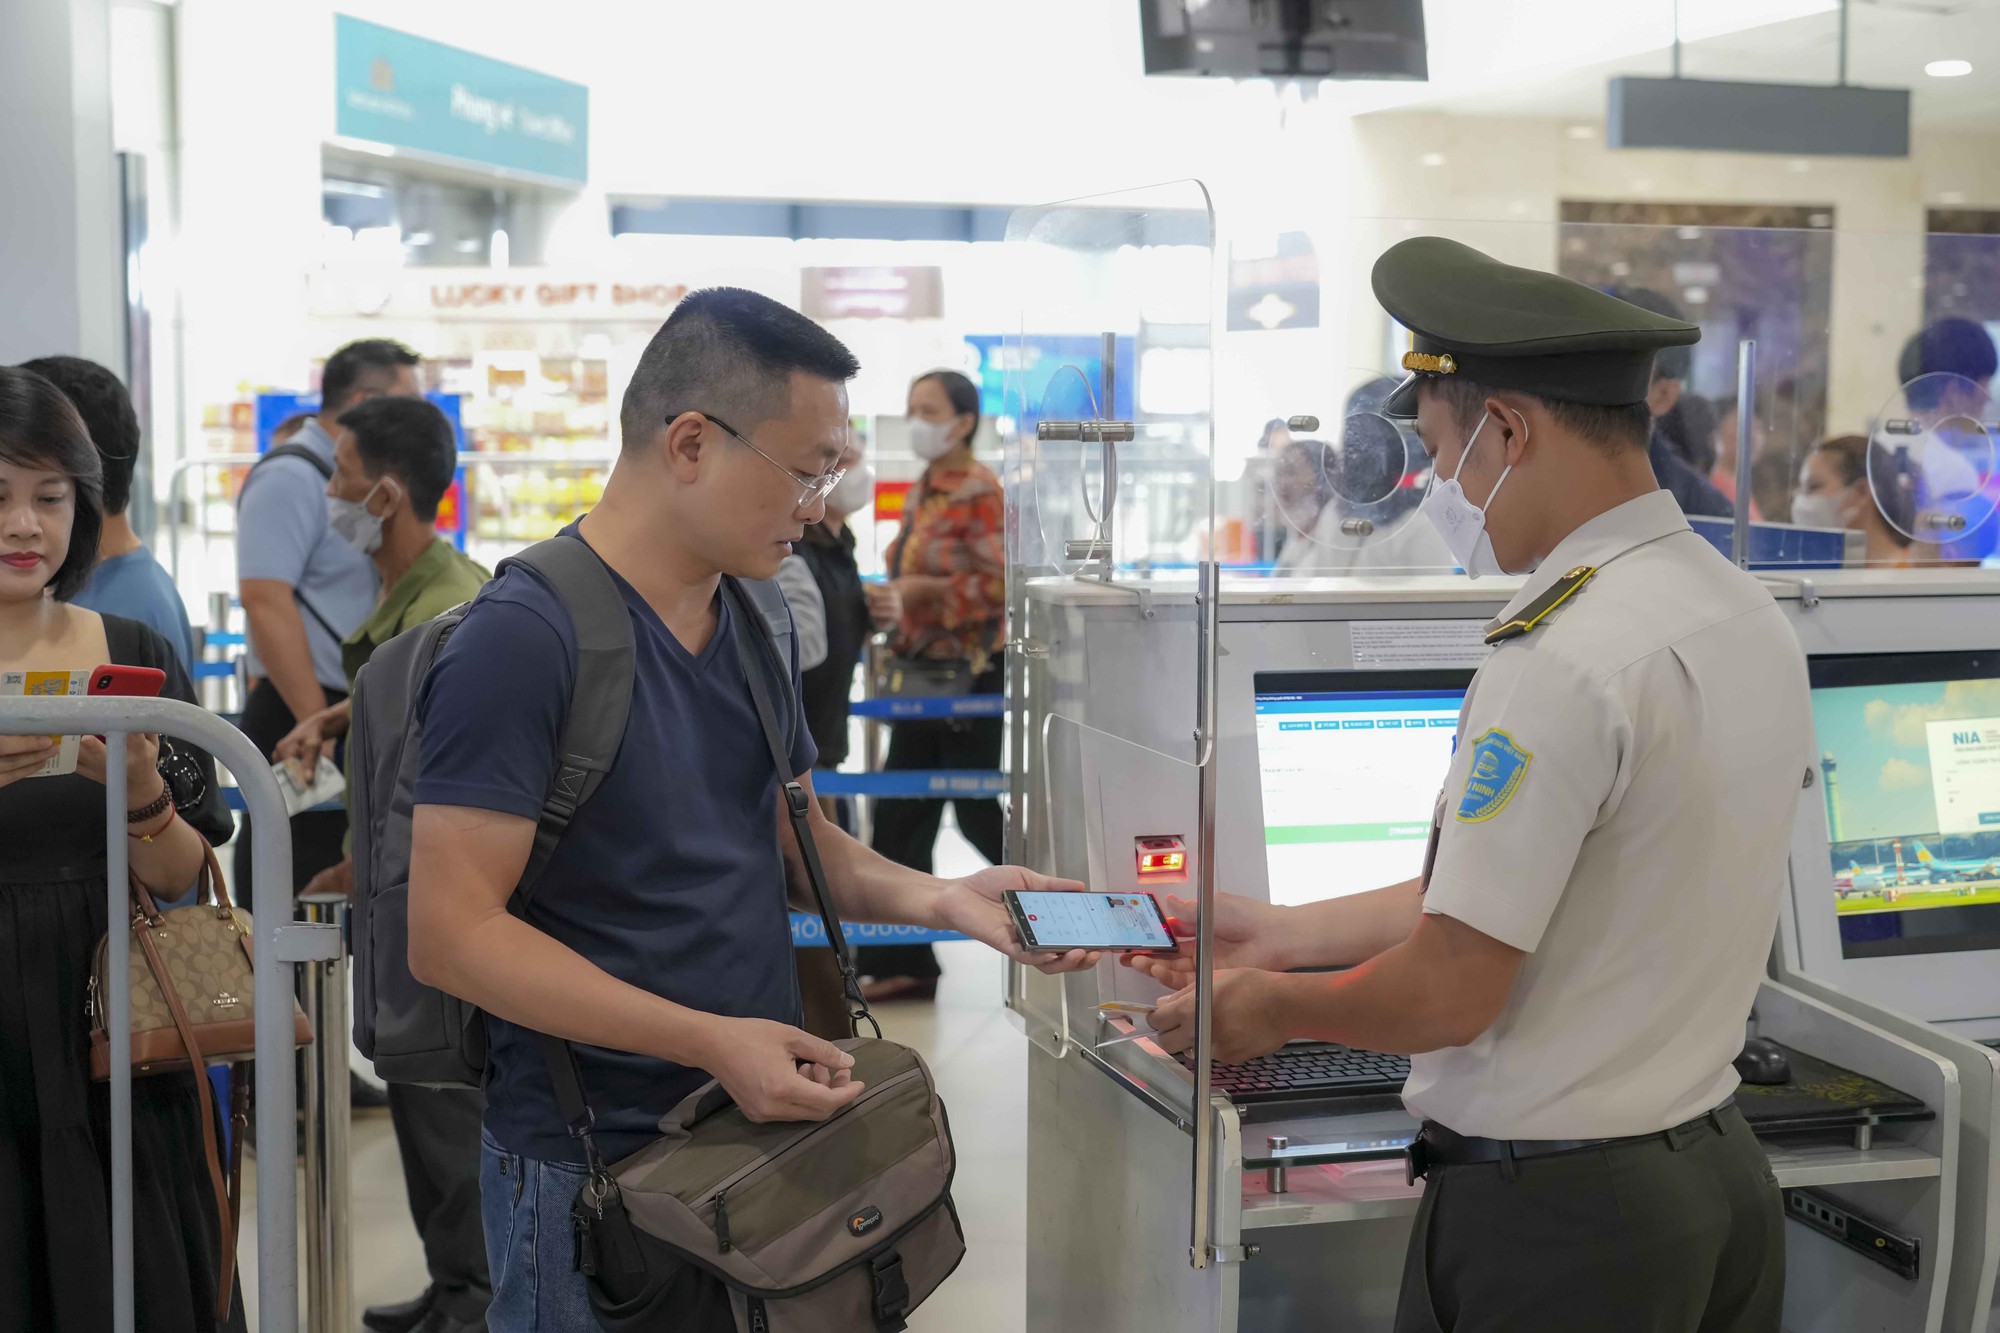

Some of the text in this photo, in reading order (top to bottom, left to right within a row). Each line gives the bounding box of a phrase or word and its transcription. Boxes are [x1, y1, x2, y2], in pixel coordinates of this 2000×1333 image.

[430, 283, 525, 308] LUCKY
[535, 283, 598, 307] GIFT
[1953, 731, 1980, 745] NIA
[1472, 781, 1495, 798] NINH
